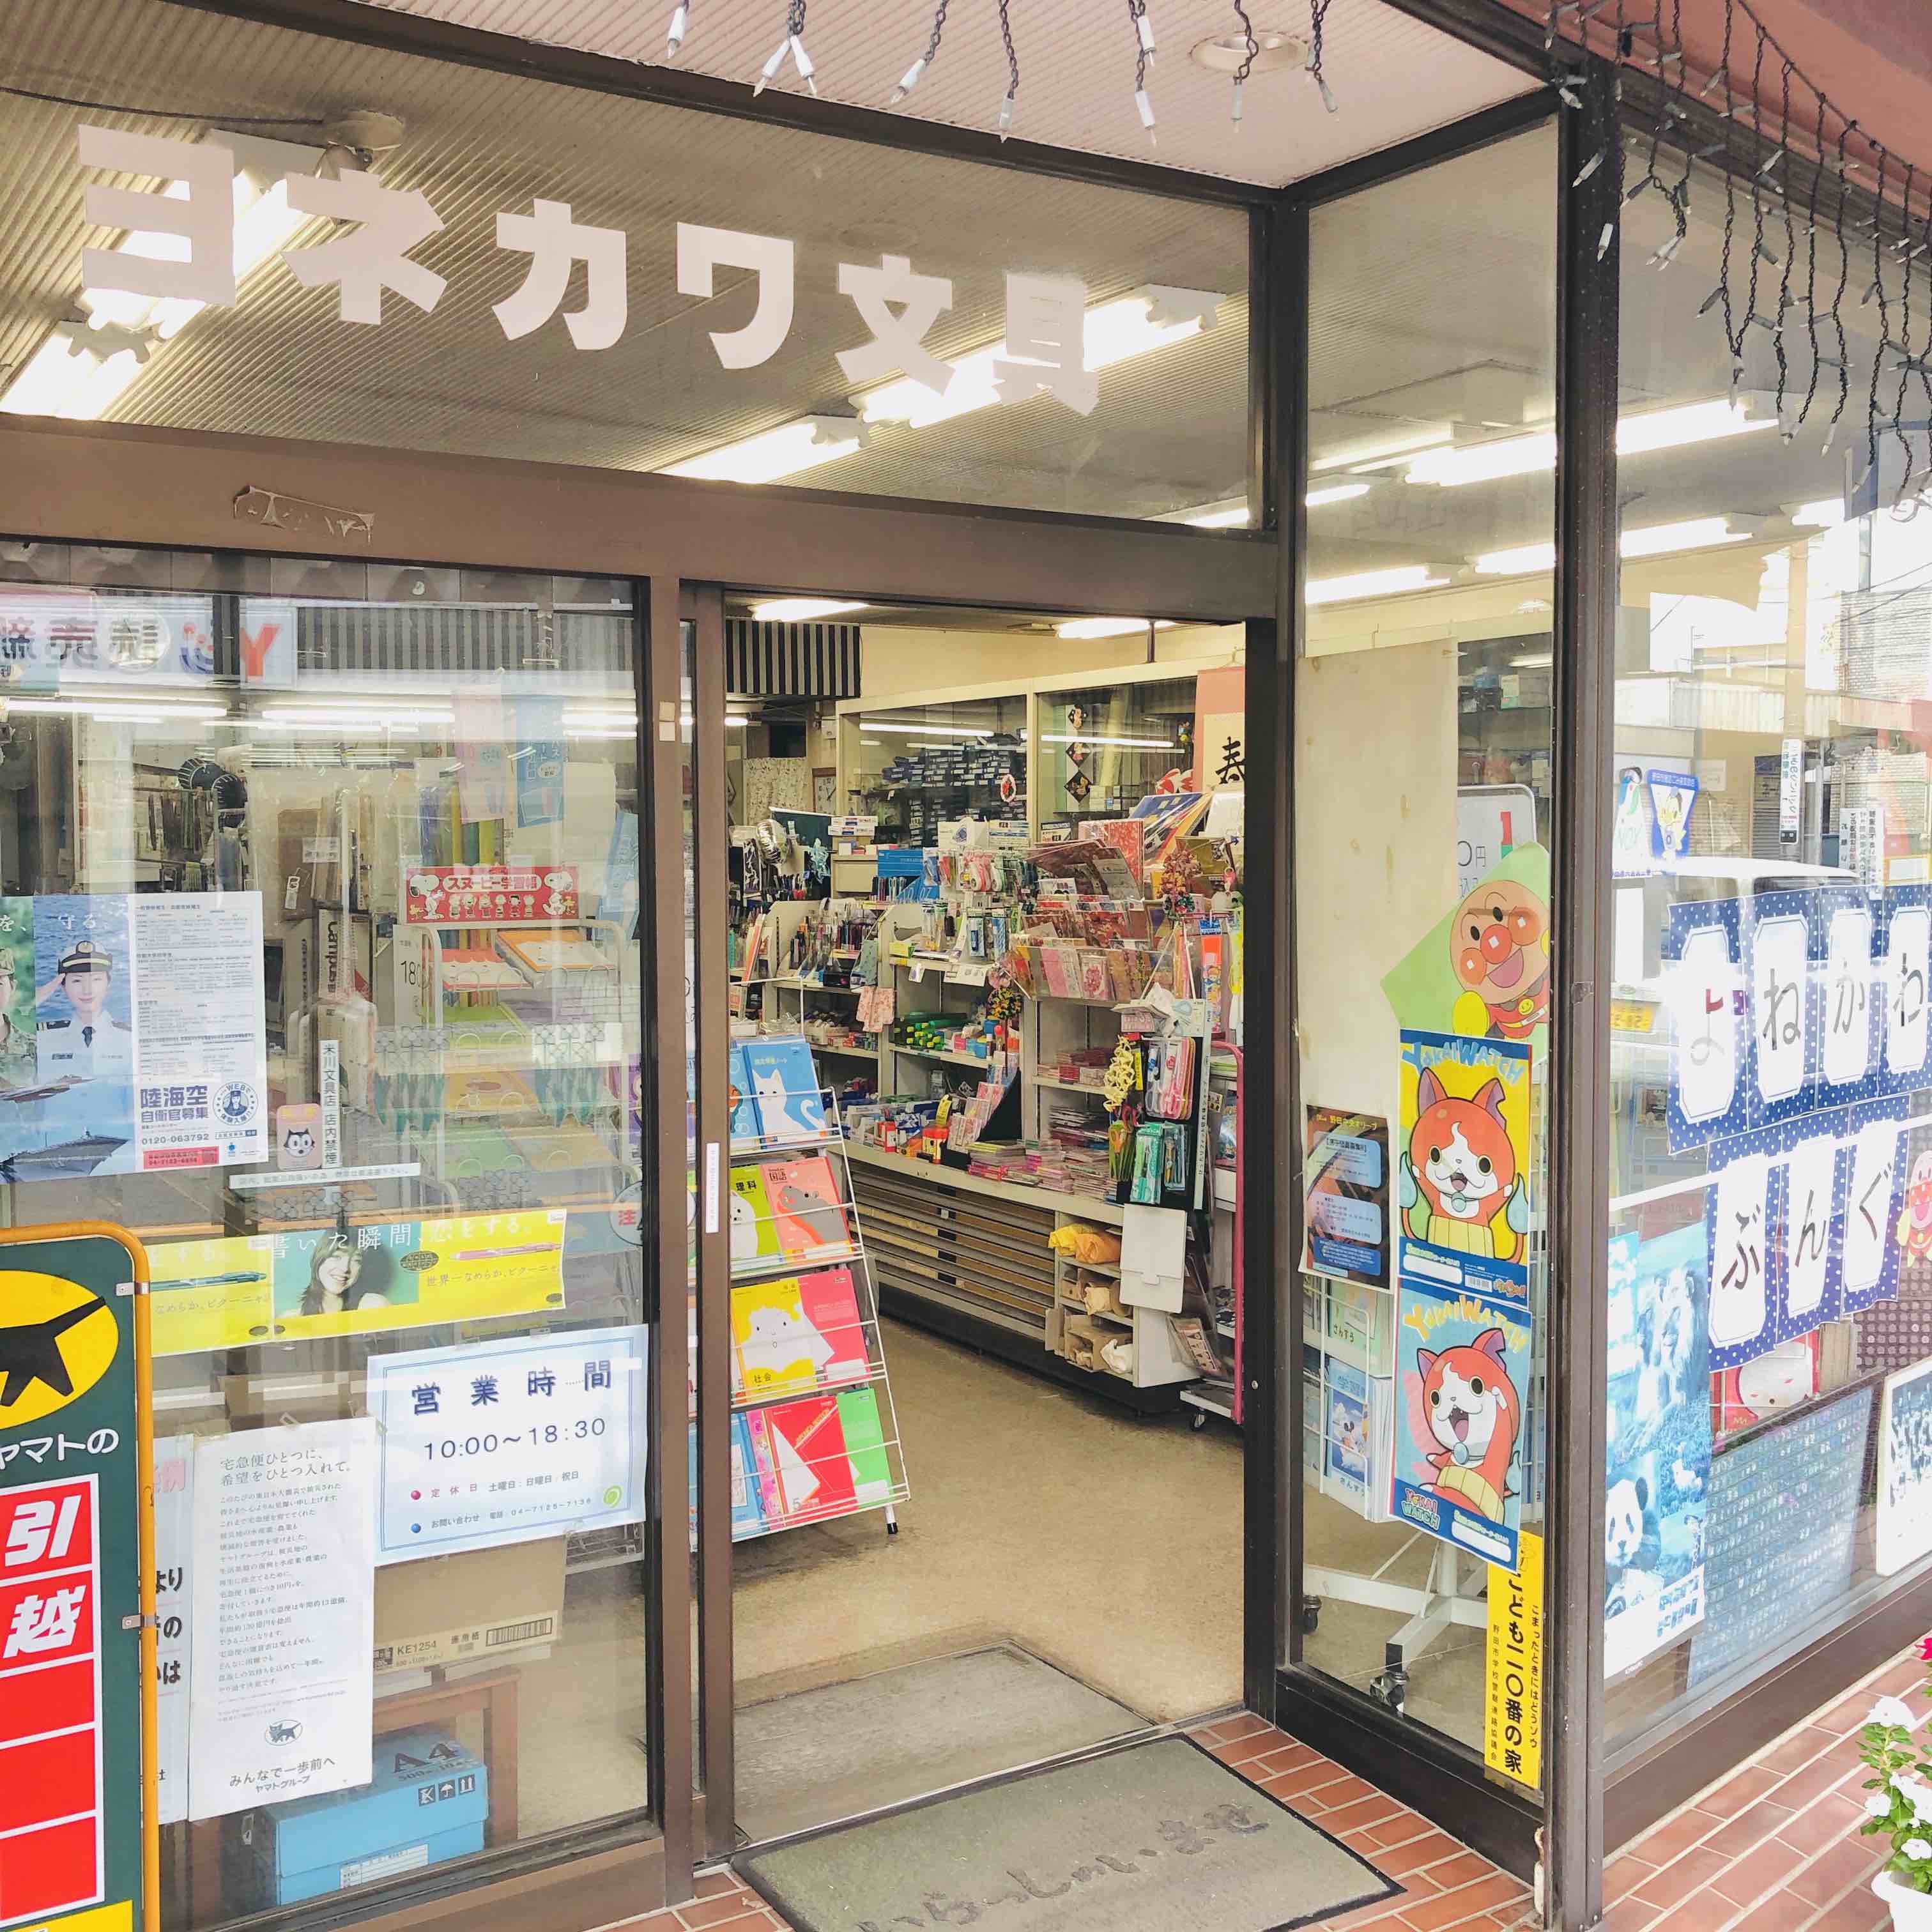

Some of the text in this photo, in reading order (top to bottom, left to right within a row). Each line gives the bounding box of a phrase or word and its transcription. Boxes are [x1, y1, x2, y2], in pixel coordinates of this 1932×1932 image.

[79, 124, 1099, 416] ヨネカワ文具
[1690, 952, 1924, 1067] よねかわ
[140, 1085, 208, 1108] 陸海空
[141, 1107, 210, 1123] 自衛官募集
[142, 1133, 210, 1145] 0120-063792
[735, 1180, 757, 1192] 理科
[769, 1171, 788, 1183] 国語
[1721, 1163, 1892, 1291] ぶんぐ
[411, 1358, 612, 1416] 営業時間
[754, 1372, 772, 1384] 社会
[220, 1449, 323, 1471] 宅急便ひとつに、
[220, 1461, 350, 1486] 希望をひとつ入れて。
[430, 1483, 478, 1499] 定休日
[431, 1514, 480, 1529] お問い合わせ
[3, 1494, 87, 1659] 引越
[396, 1640, 438, 1657] KE1254
[229, 1757, 336, 1788] みんなで一歩前へ
[256, 1775, 311, 1794] ヤマトグループ
